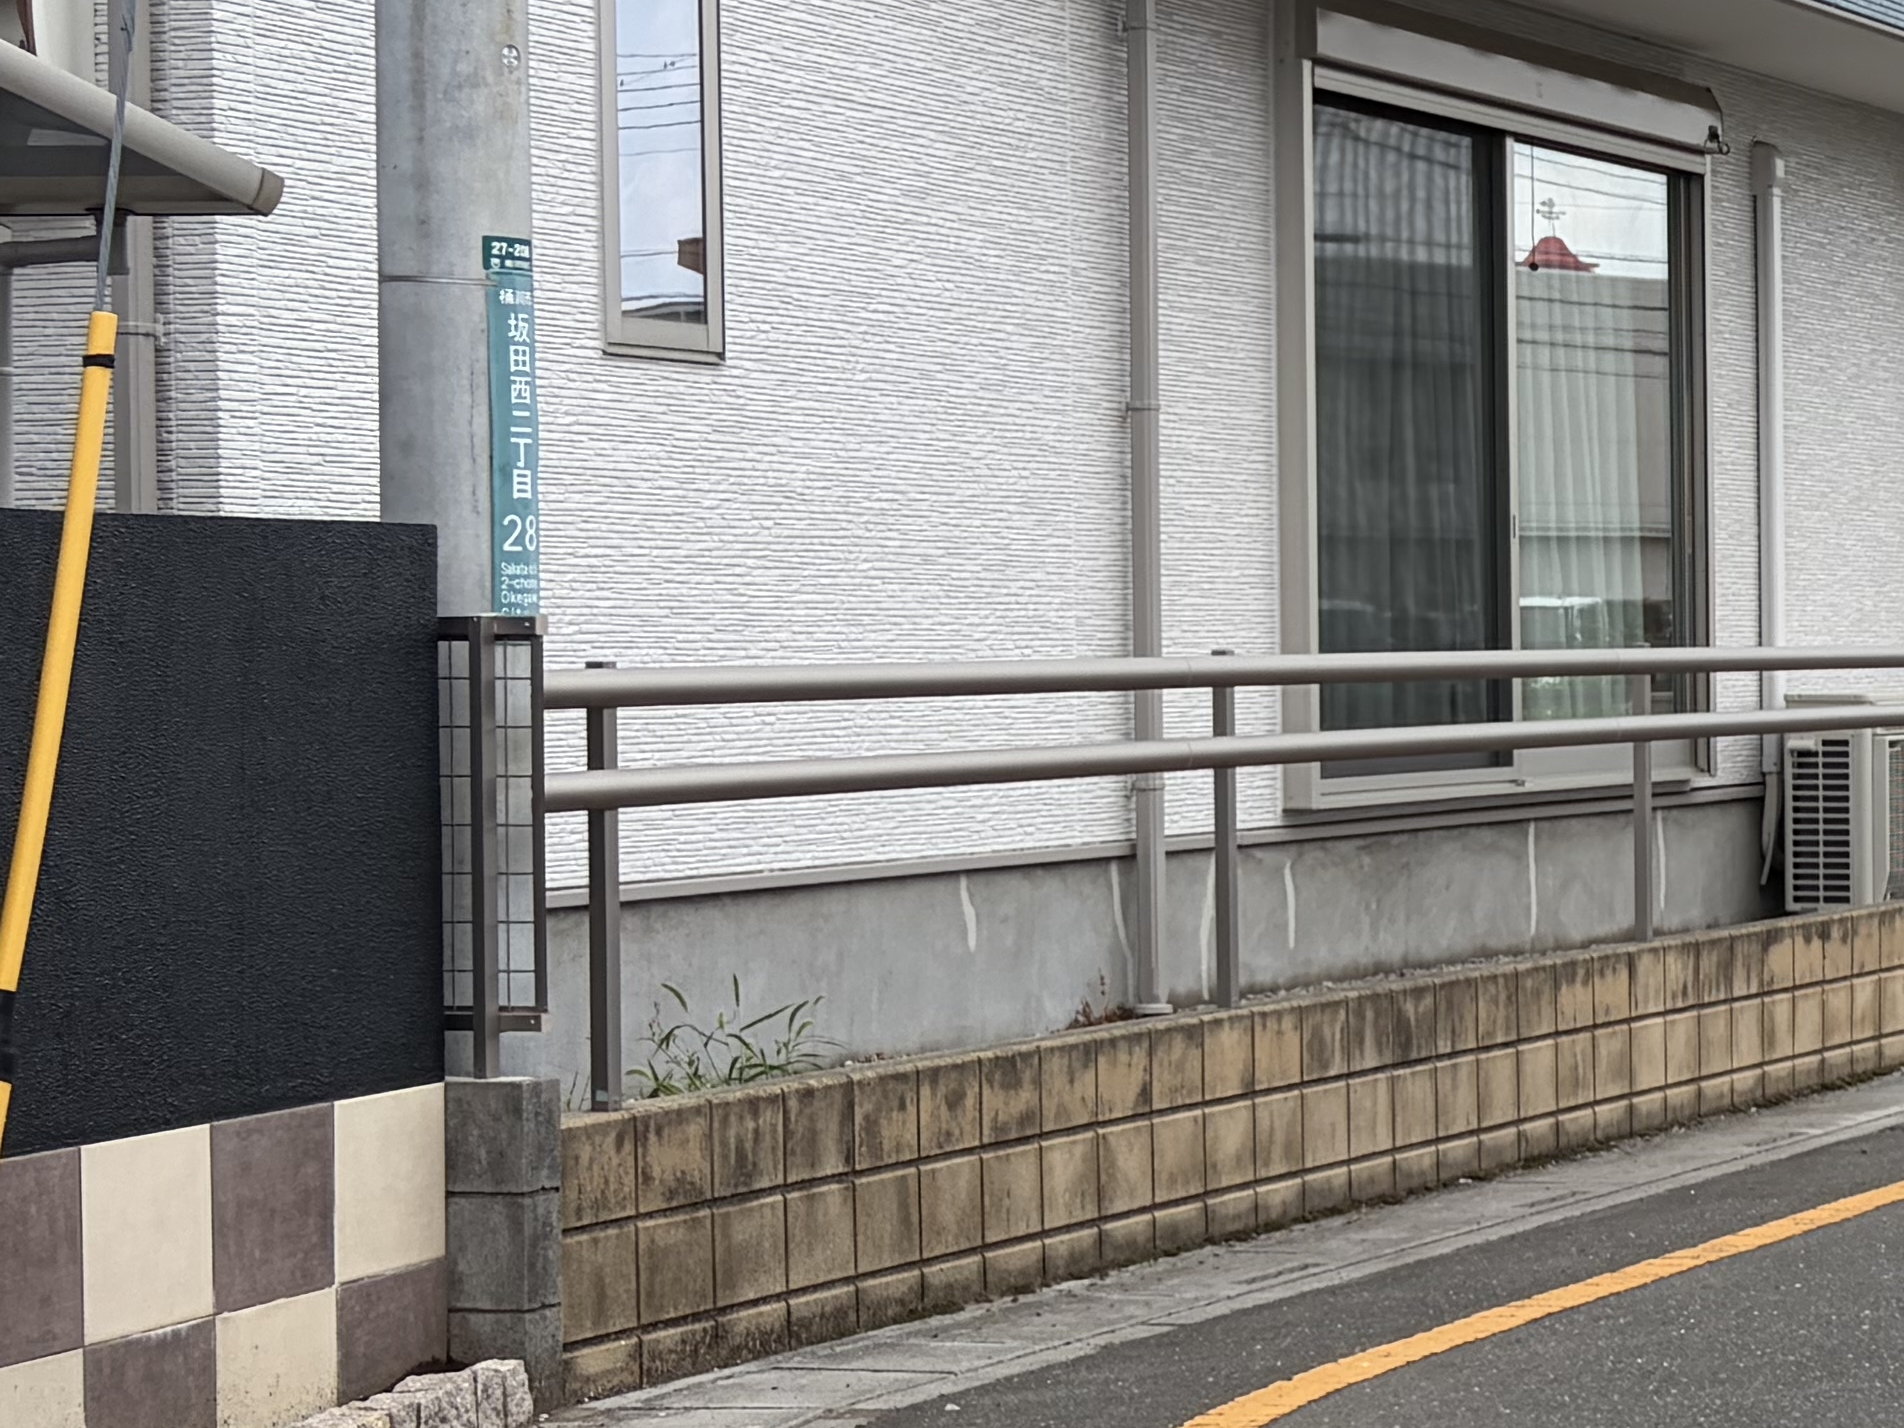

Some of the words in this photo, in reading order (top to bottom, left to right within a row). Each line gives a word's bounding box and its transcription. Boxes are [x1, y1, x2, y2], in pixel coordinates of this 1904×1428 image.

[507, 312, 533, 500] 坂田西二丁目
[503, 514, 537, 552] 28
